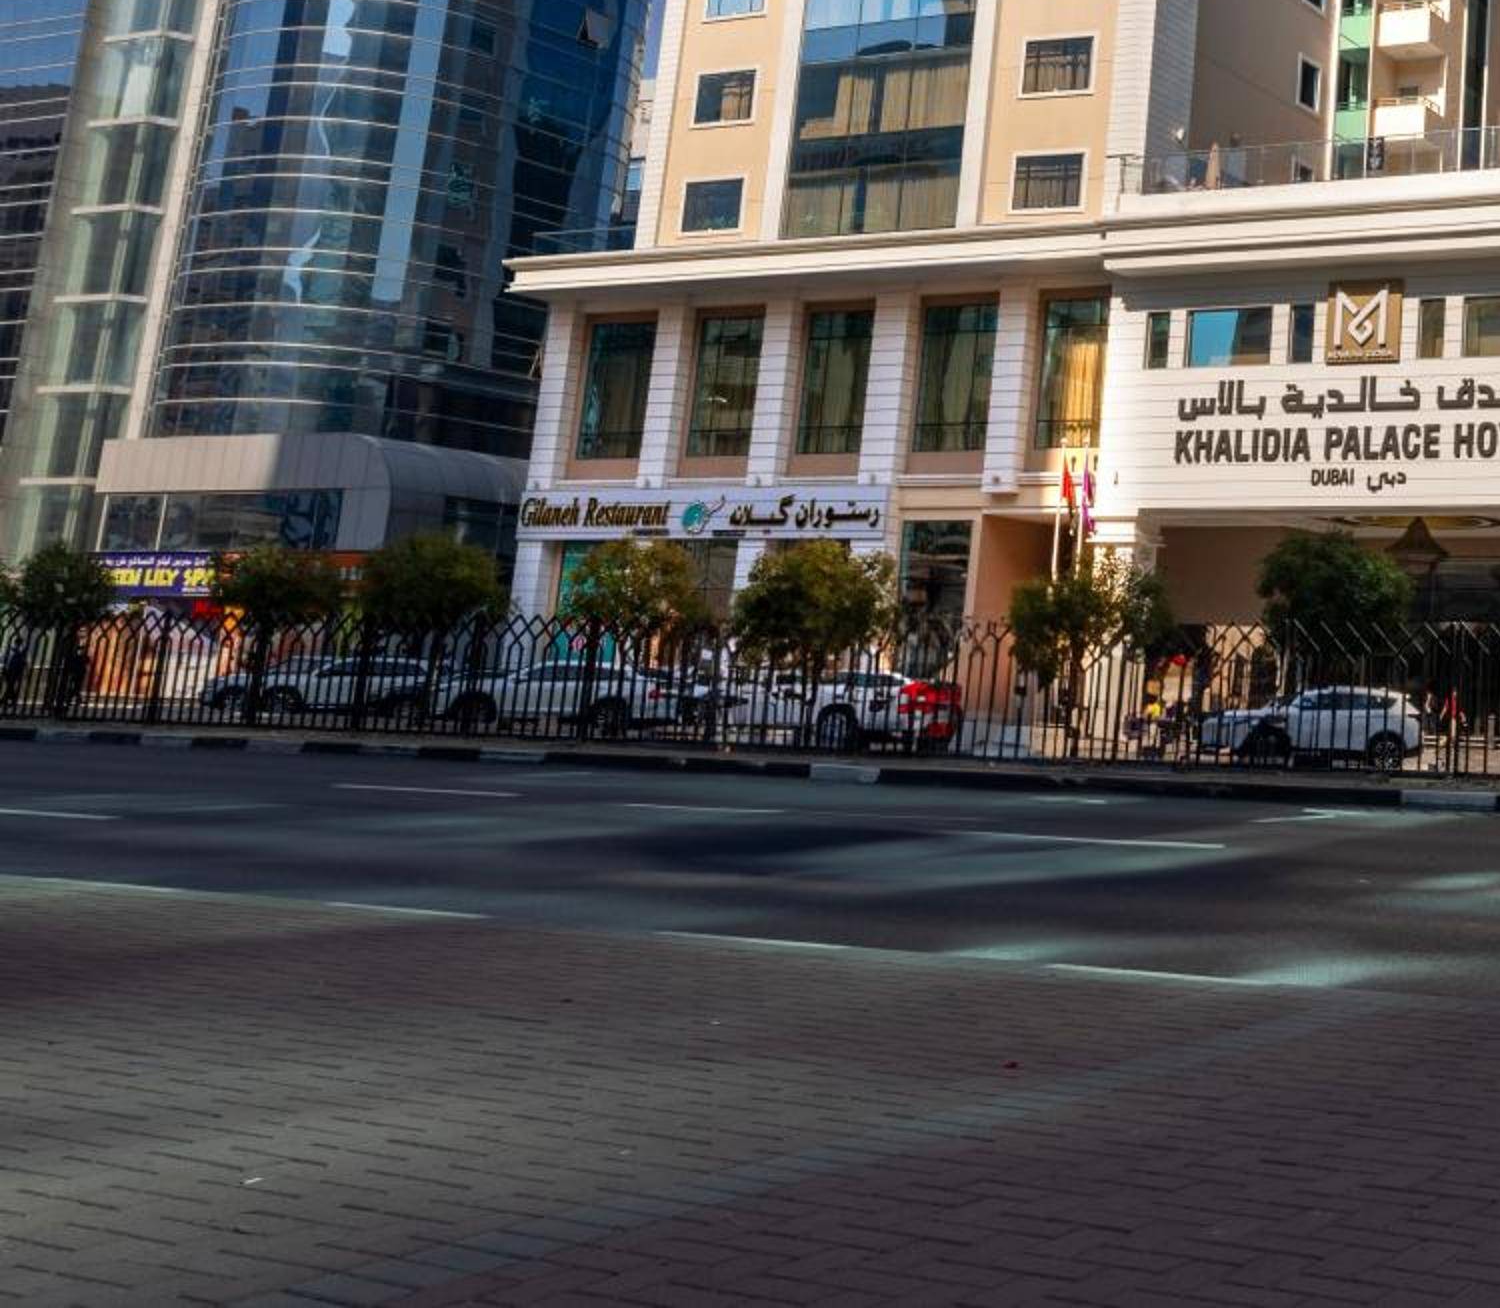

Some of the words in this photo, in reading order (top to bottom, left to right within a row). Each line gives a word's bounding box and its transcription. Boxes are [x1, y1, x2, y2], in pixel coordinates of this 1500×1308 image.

[1177, 379, 1267, 422] بالاس
[1281, 376, 1421, 419] خالدية
[1174, 428, 1311, 465] KHALIDIA
[1323, 423, 1441, 462] PALACE
[1311, 468, 1355, 487] DUBAI
[582, 497, 671, 528] Restaurant
